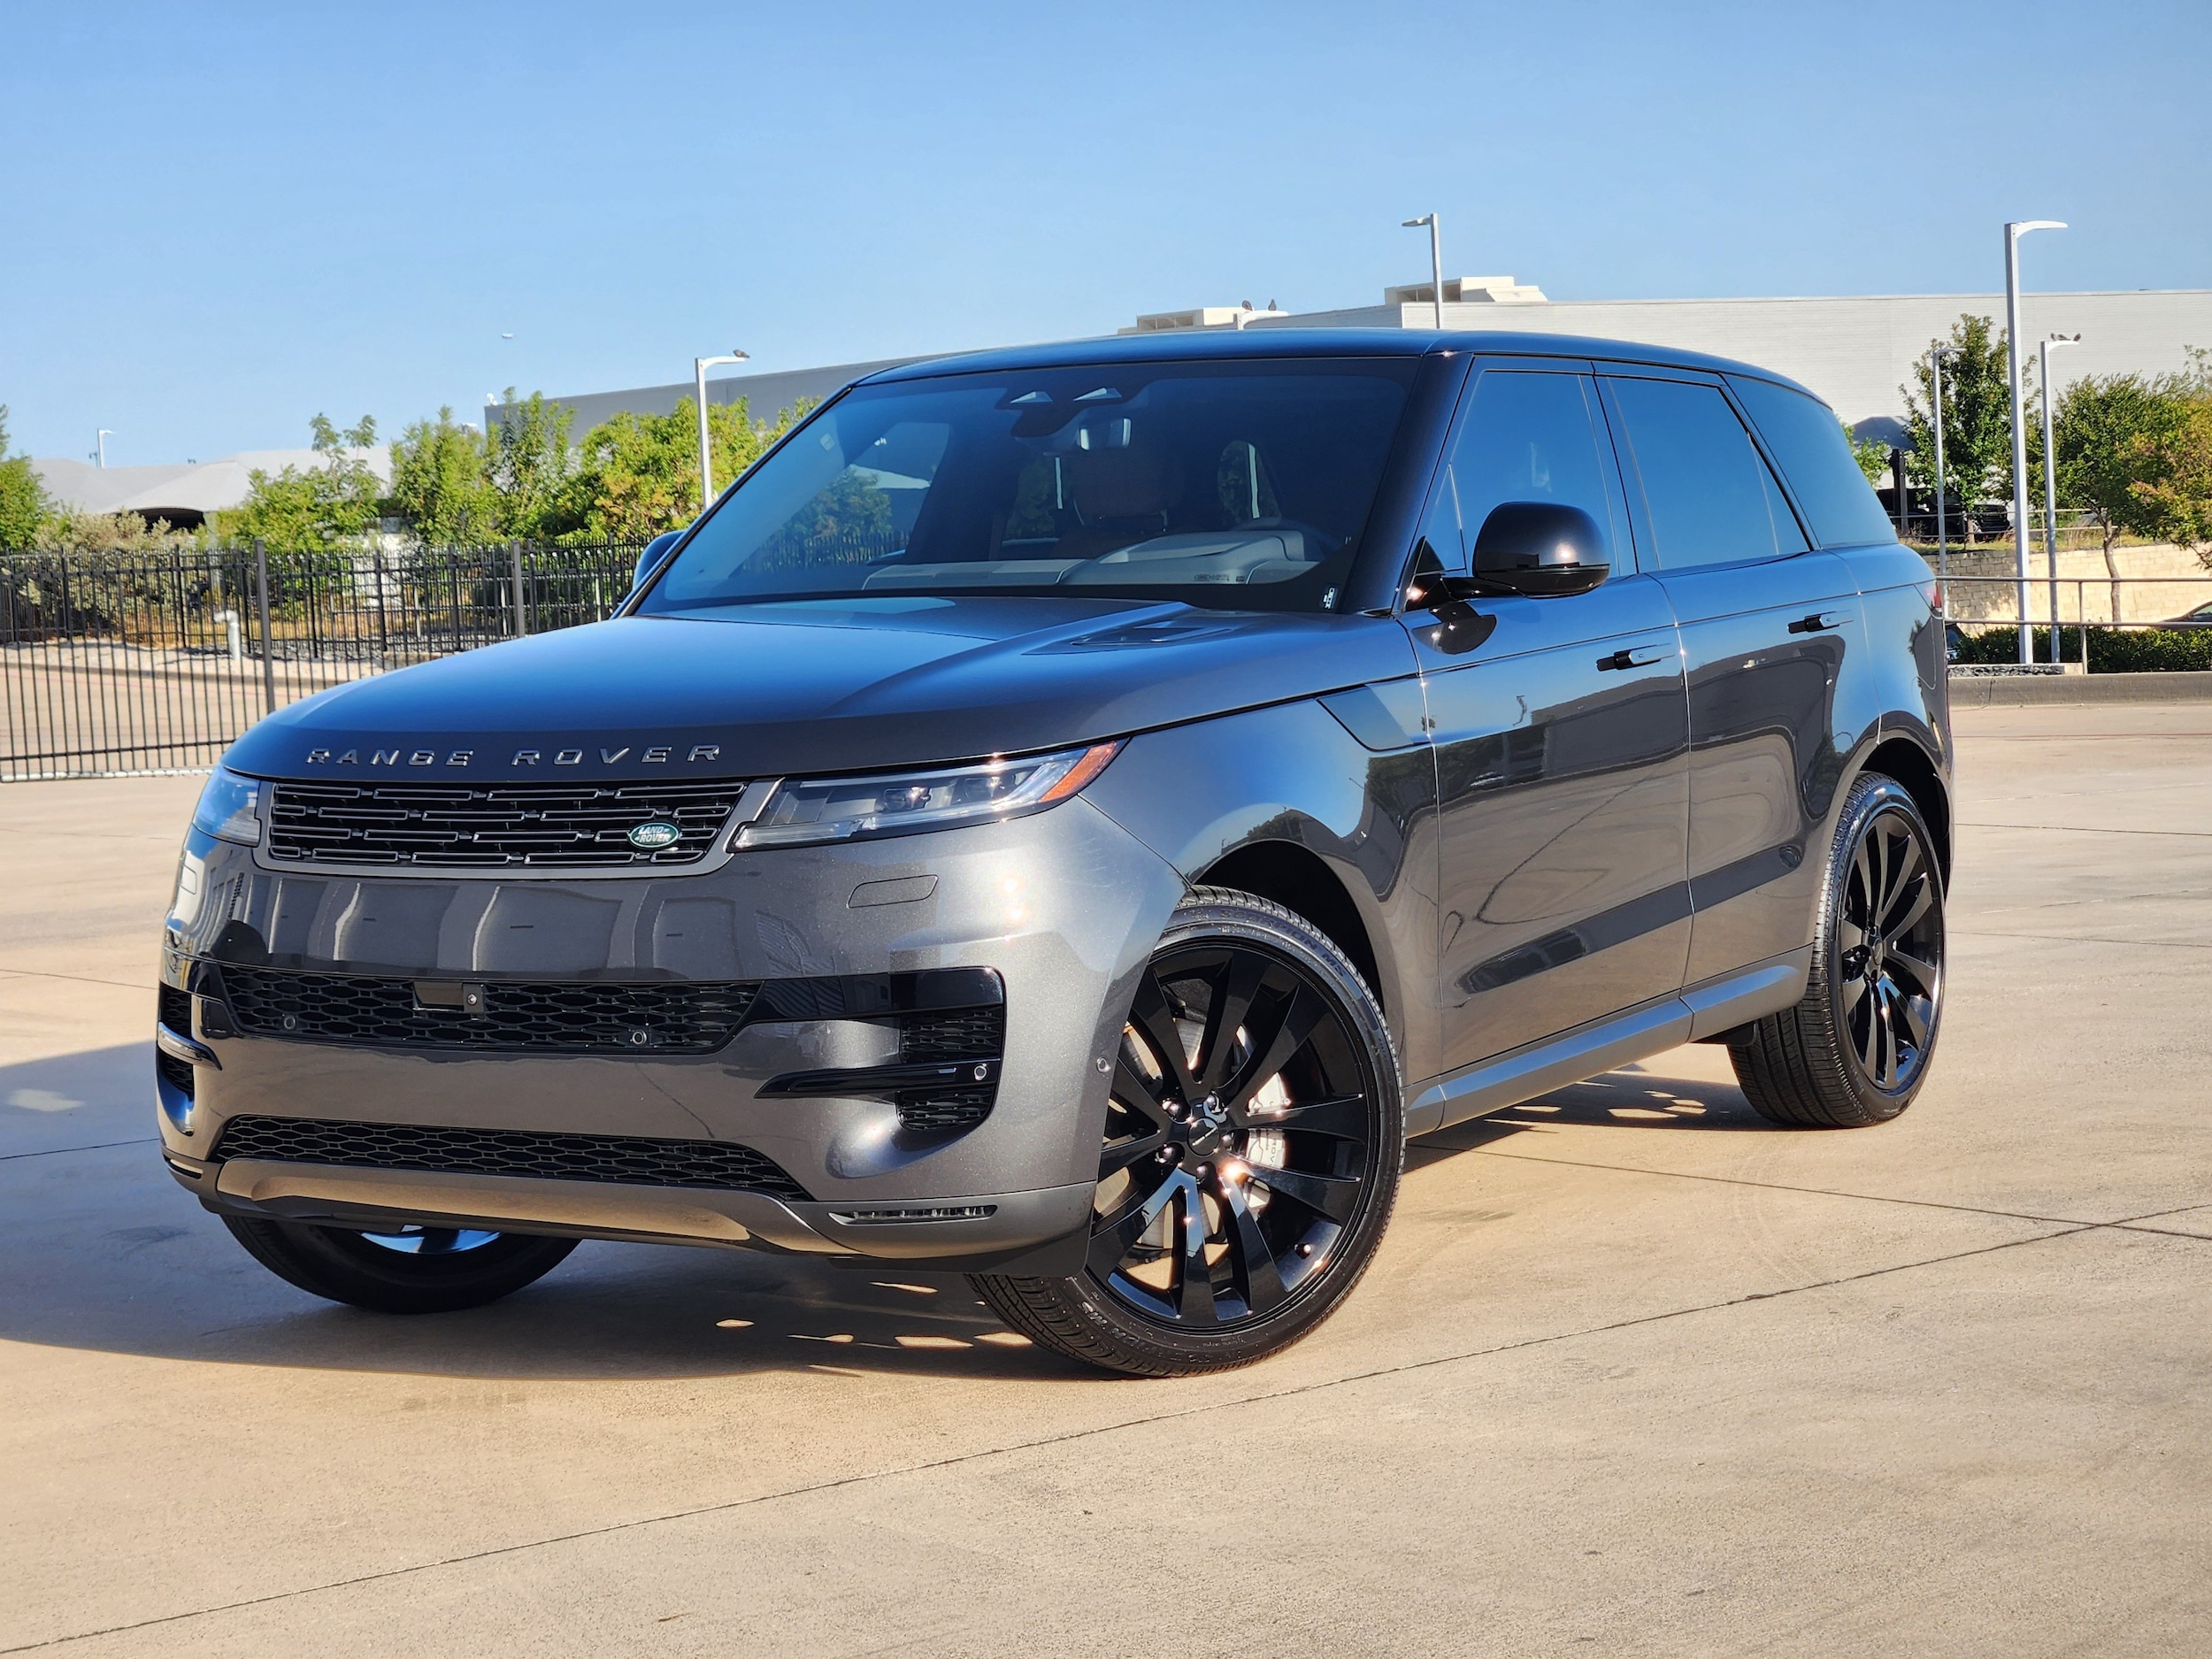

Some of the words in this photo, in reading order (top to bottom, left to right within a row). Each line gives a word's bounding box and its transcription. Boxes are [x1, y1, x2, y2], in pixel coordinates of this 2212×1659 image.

[306, 748, 473, 767] RANGE
[511, 744, 721, 767] ROVER
[638, 826, 664, 835] LAND
[639, 833, 672, 842] ROVER
